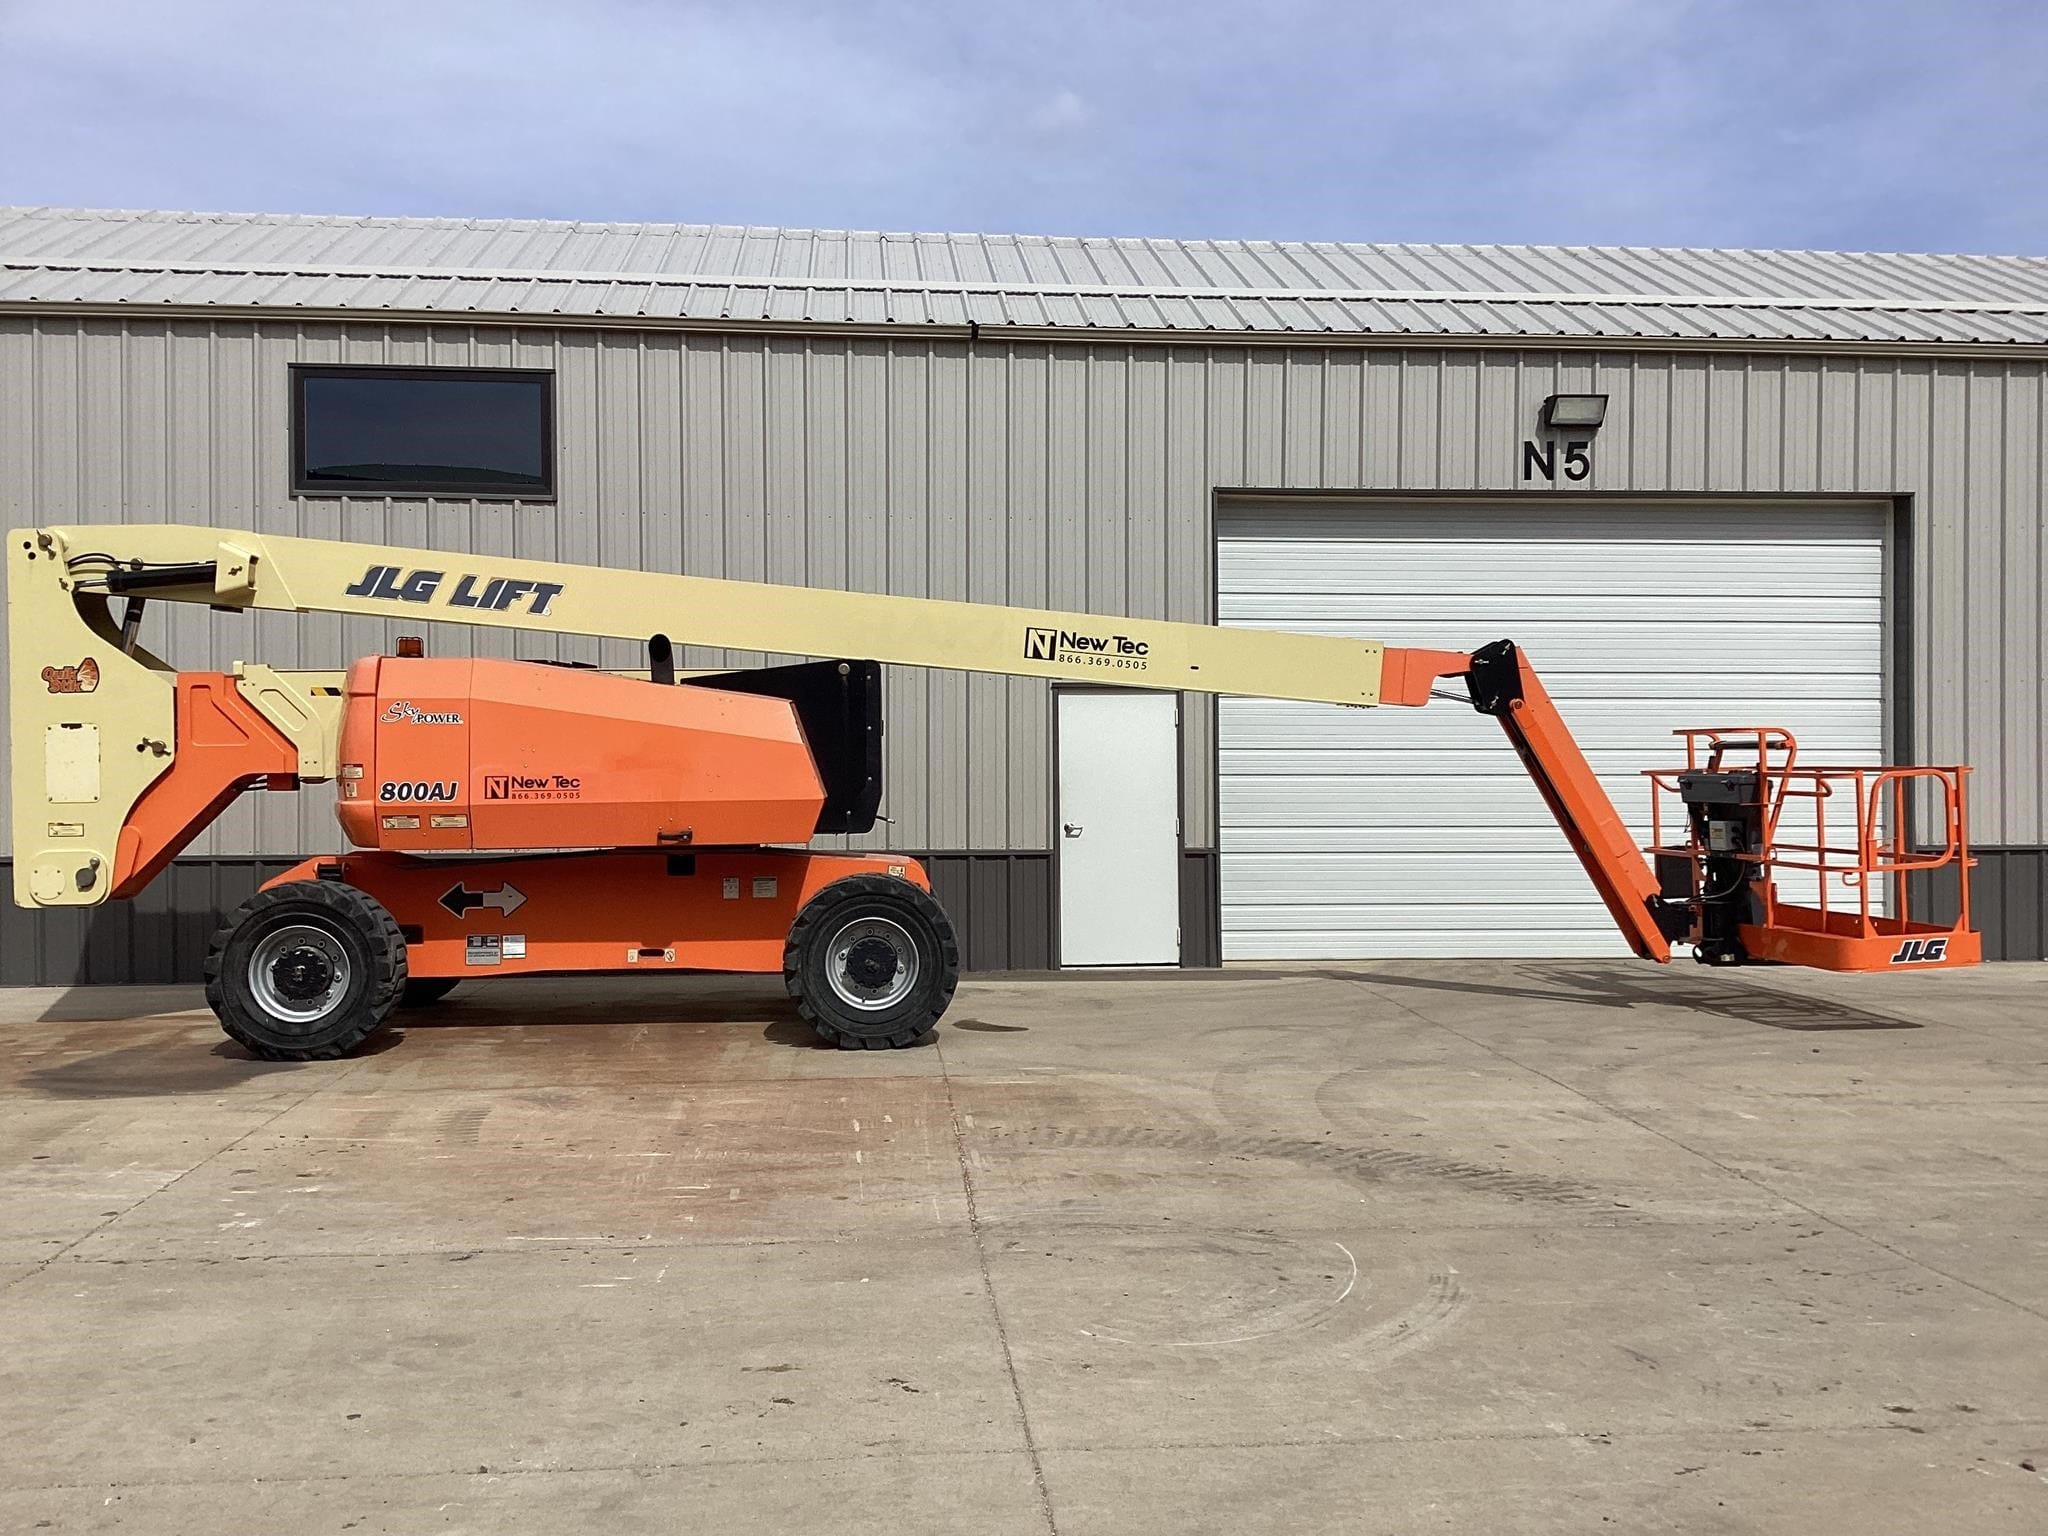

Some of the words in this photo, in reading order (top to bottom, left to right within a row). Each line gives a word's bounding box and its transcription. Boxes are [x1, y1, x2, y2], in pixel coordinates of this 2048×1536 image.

[345, 566, 444, 603] JLG
[449, 575, 564, 614] LIFT
[1060, 631, 1109, 651] New
[1112, 635, 1149, 655] Tec
[1058, 654, 1148, 670] 866.369.0505
[381, 701, 420, 723] Sky
[417, 713, 459, 723] POWER
[380, 782, 457, 801] 800AJ
[511, 776, 549, 788] New
[552, 776, 580, 788] Tec
[1891, 938, 1947, 963] JLG
